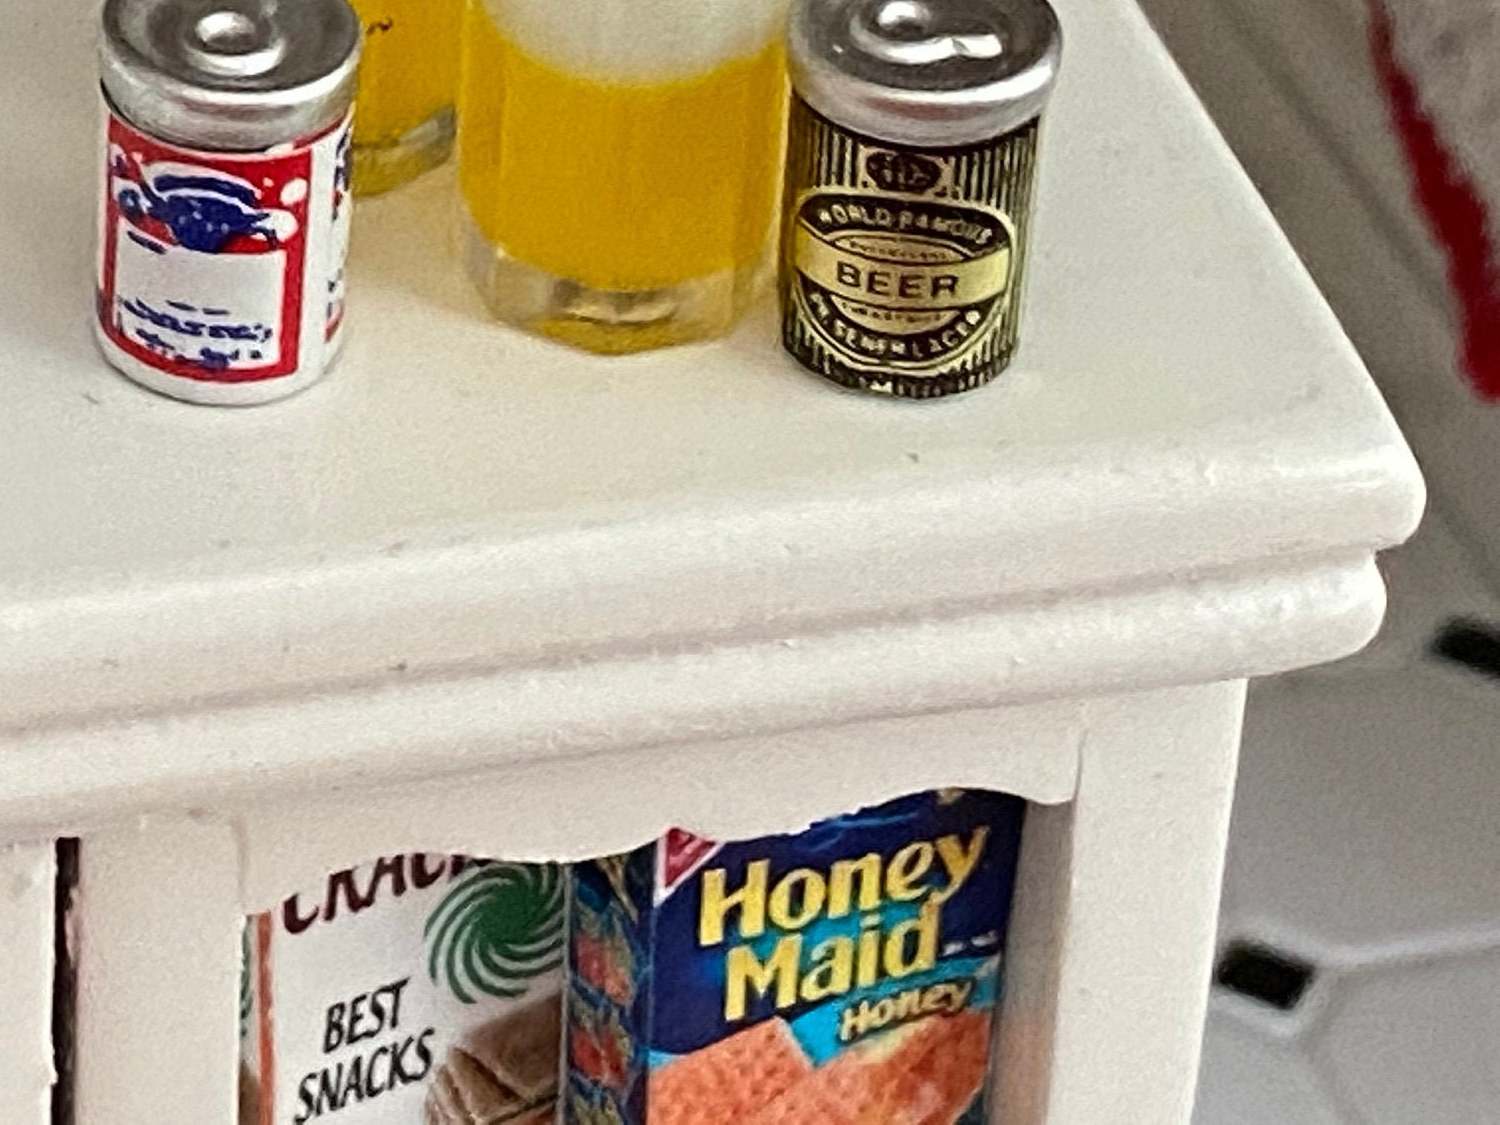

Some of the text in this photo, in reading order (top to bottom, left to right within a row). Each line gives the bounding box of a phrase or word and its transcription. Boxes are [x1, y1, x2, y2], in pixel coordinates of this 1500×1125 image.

[819, 203, 892, 227] WORLD
[837, 260, 959, 300] BEER
[699, 825, 990, 946] Honey
[724, 898, 942, 1022] Maid
[323, 976, 411, 1054] BEST
[840, 980, 973, 1042] Honey
[293, 1026, 436, 1125] SNACKS
